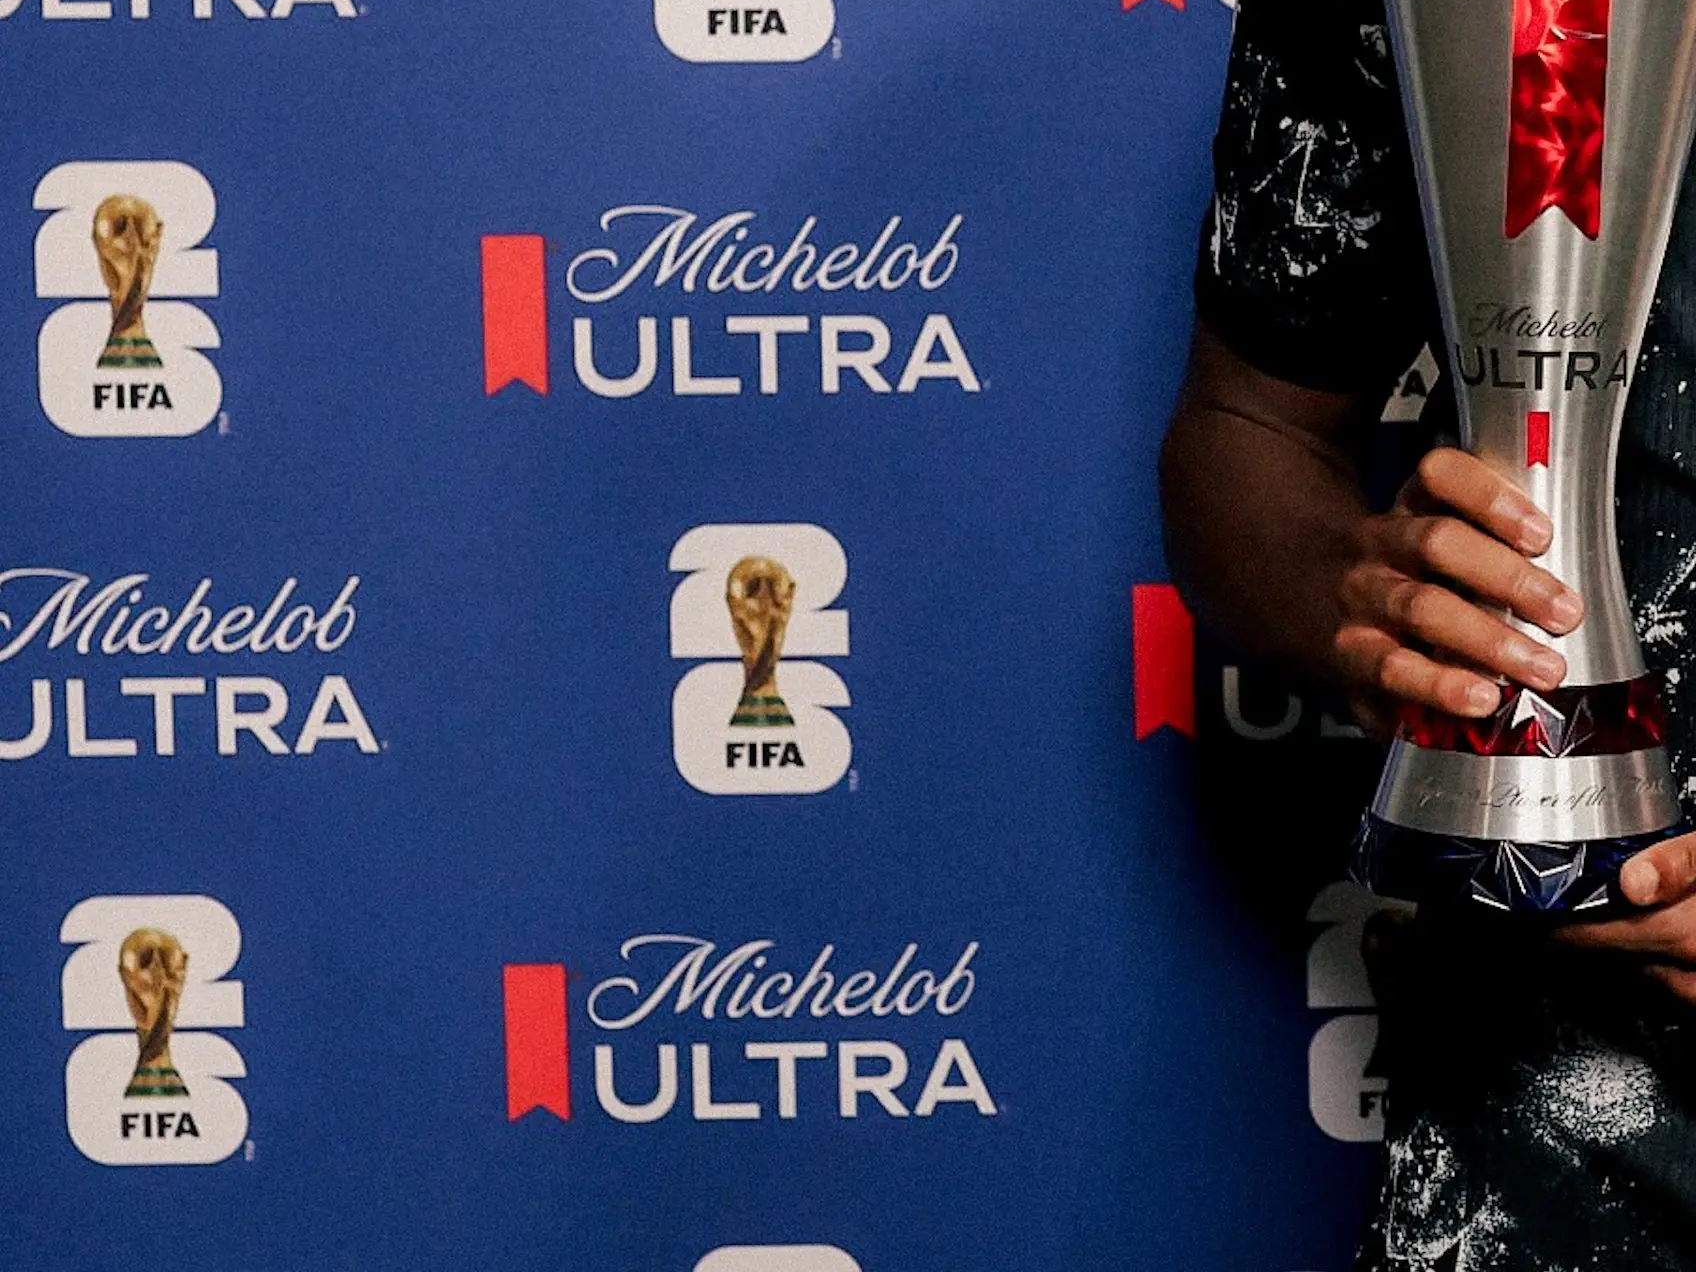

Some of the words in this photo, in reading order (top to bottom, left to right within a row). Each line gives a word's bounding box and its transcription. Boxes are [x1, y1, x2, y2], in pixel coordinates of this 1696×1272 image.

[708, 9, 787, 35] FIFA
[566, 205, 962, 302] Michelob
[574, 315, 980, 397] ULTRA
[1455, 344, 1629, 391] ULTRA
[93, 383, 173, 410] FIFA
[0, 568, 359, 661] Michelob
[726, 741, 805, 768] FIFA
[588, 935, 978, 1029] Michelob
[595, 1040, 996, 1122] ULTRA
[121, 1112, 200, 1138] FIFA
